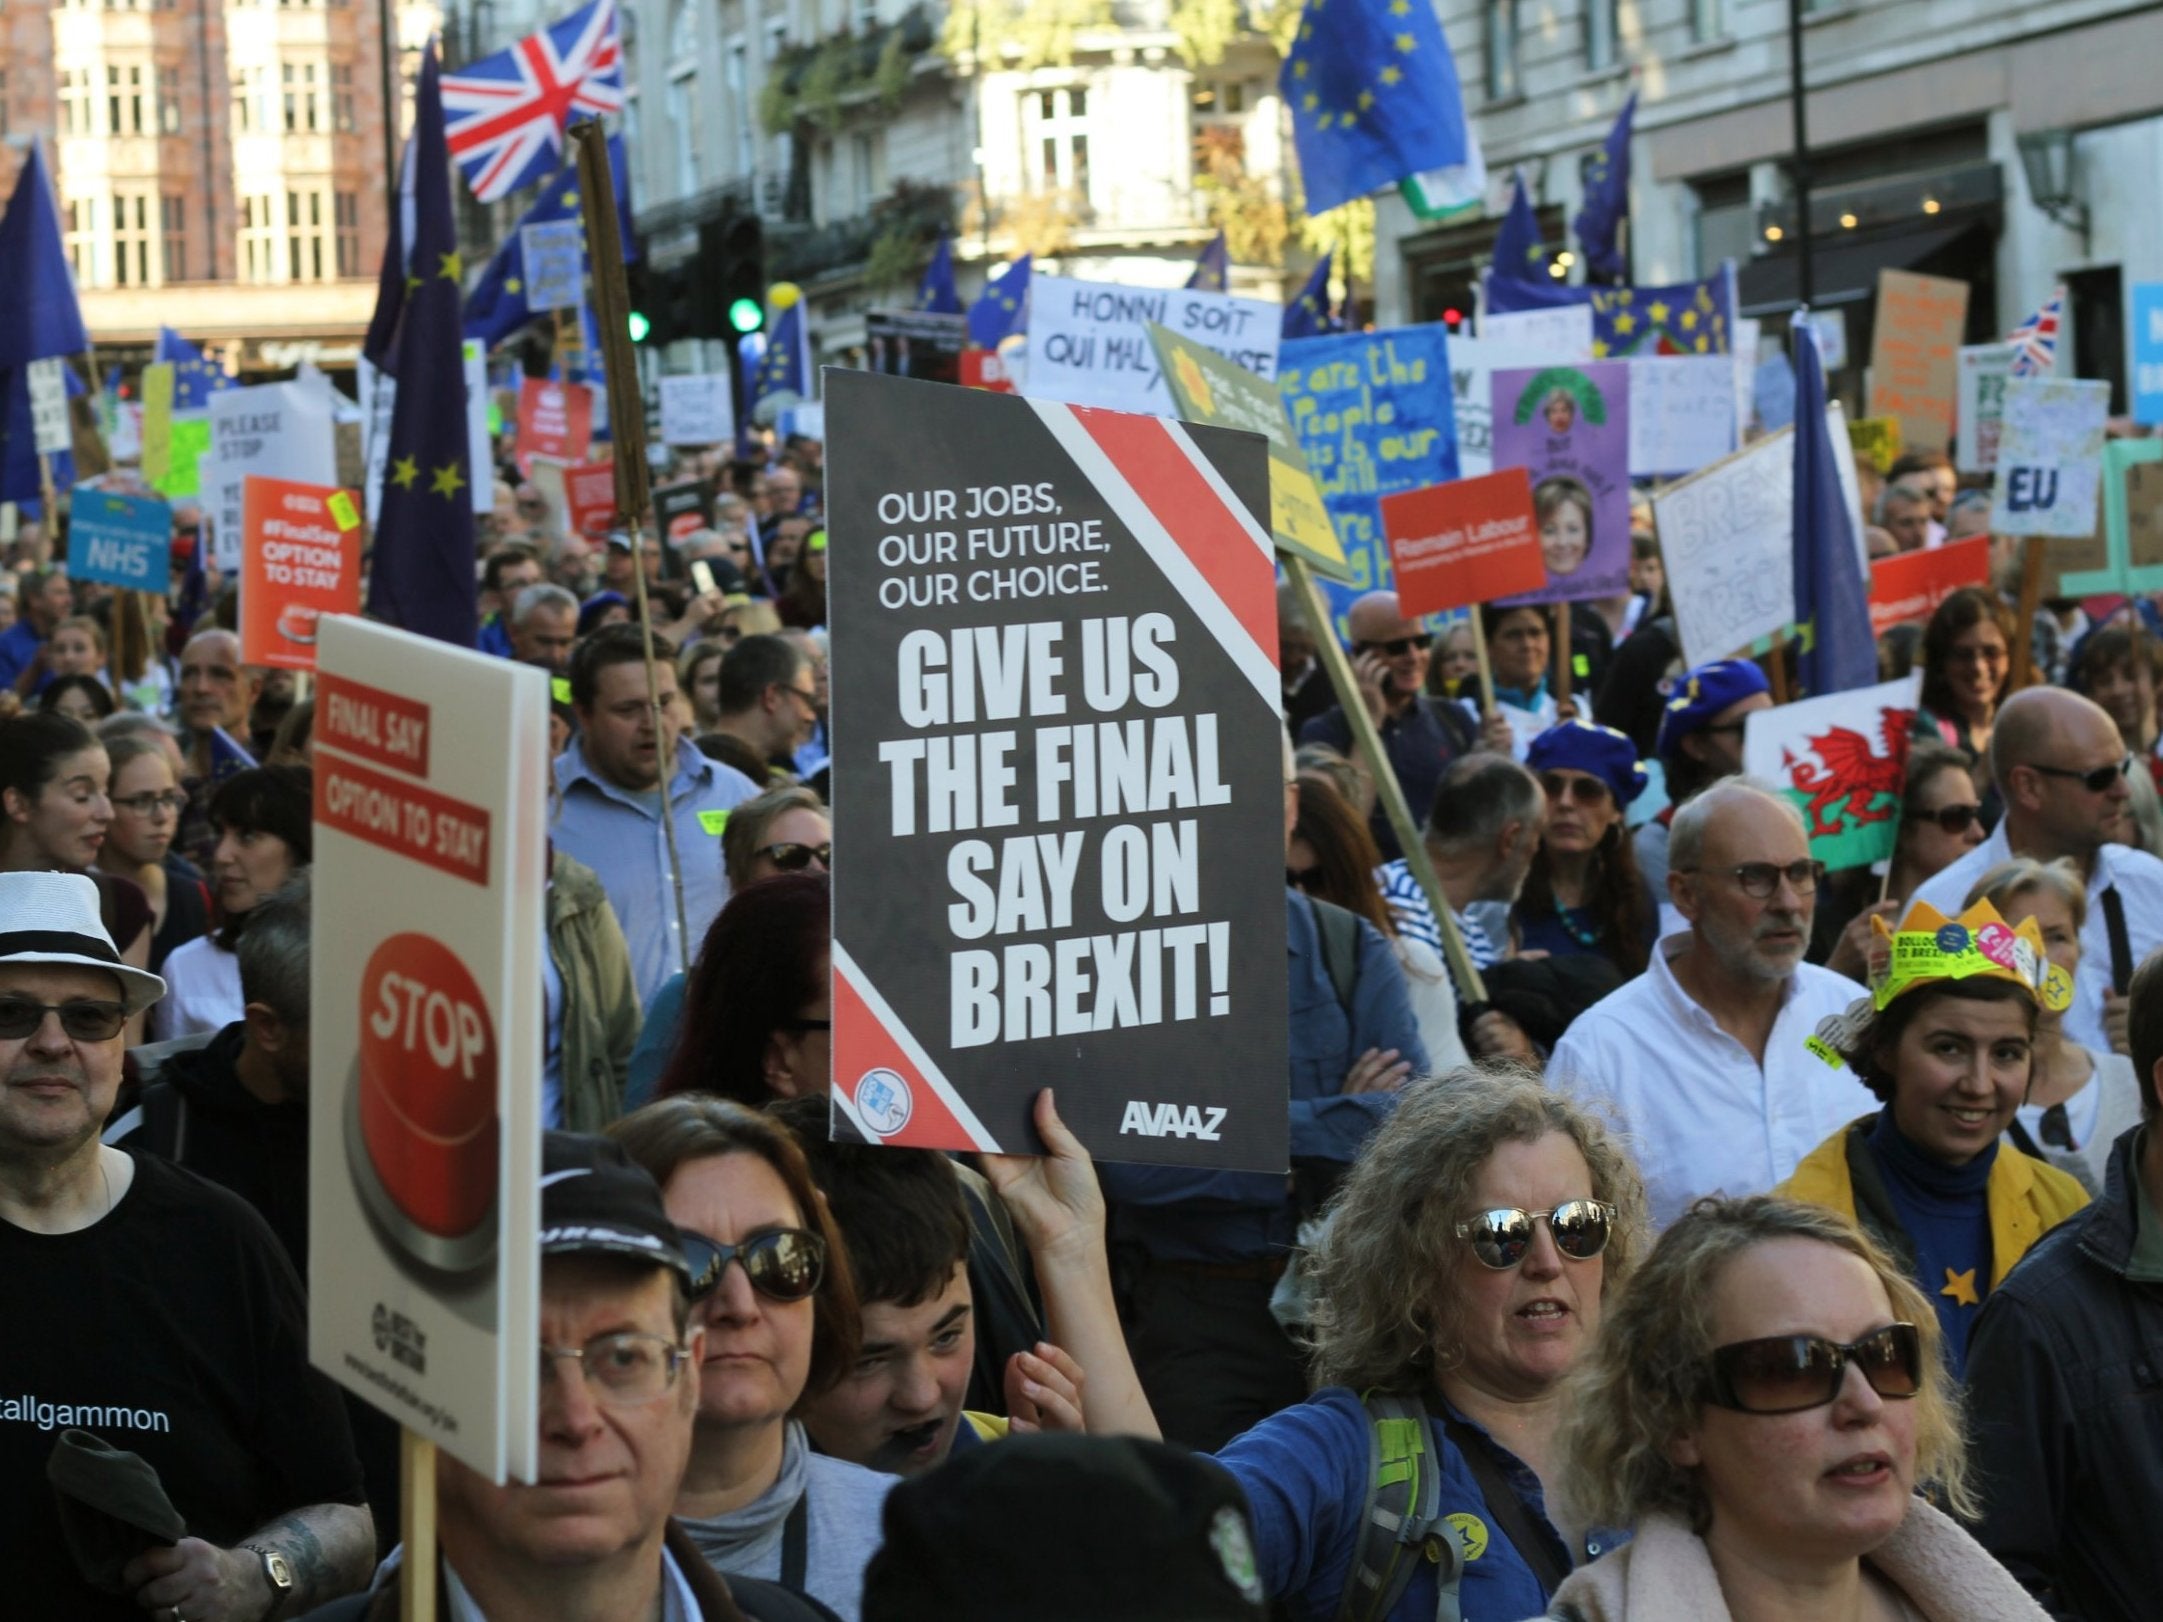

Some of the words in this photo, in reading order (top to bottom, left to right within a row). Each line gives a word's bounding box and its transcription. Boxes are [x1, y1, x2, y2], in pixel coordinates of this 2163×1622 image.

[1104, 334, 1149, 373] MAL
[1367, 339, 1427, 386] the
[218, 412, 281, 436] PLEASE
[1379, 428, 1439, 460] our
[220, 438, 264, 462] STOP
[878, 490, 956, 524] OUR
[966, 483, 1062, 519] JOBS,
[2008, 465, 2059, 512] EU
[87, 535, 149, 577] NHS
[262, 541, 341, 570] OPTION
[878, 532, 957, 566] OUR
[967, 520, 1111, 560] FUTURE,
[264, 563, 292, 585] TO
[293, 566, 341, 590] STAY
[879, 574, 958, 609] OUR
[968, 561, 1109, 603] CHOICE.
[898, 621, 1067, 728] GIVE
[1081, 612, 1180, 712] US
[328, 693, 381, 746] FINAL
[385, 712, 425, 760] SAY
[878, 731, 1019, 837] THE
[1036, 713, 1232, 823] FINAL
[327, 774, 398, 836] OPTION
[404, 802, 431, 848] TO
[436, 813, 484, 868] STAY
[946, 830, 1085, 940] SAY
[1101, 819, 1200, 923] ON
[950, 921, 1230, 1049] BREXIT!
[370, 970, 485, 1080] STOP
[1119, 1101, 1227, 1141] AVAAZ
